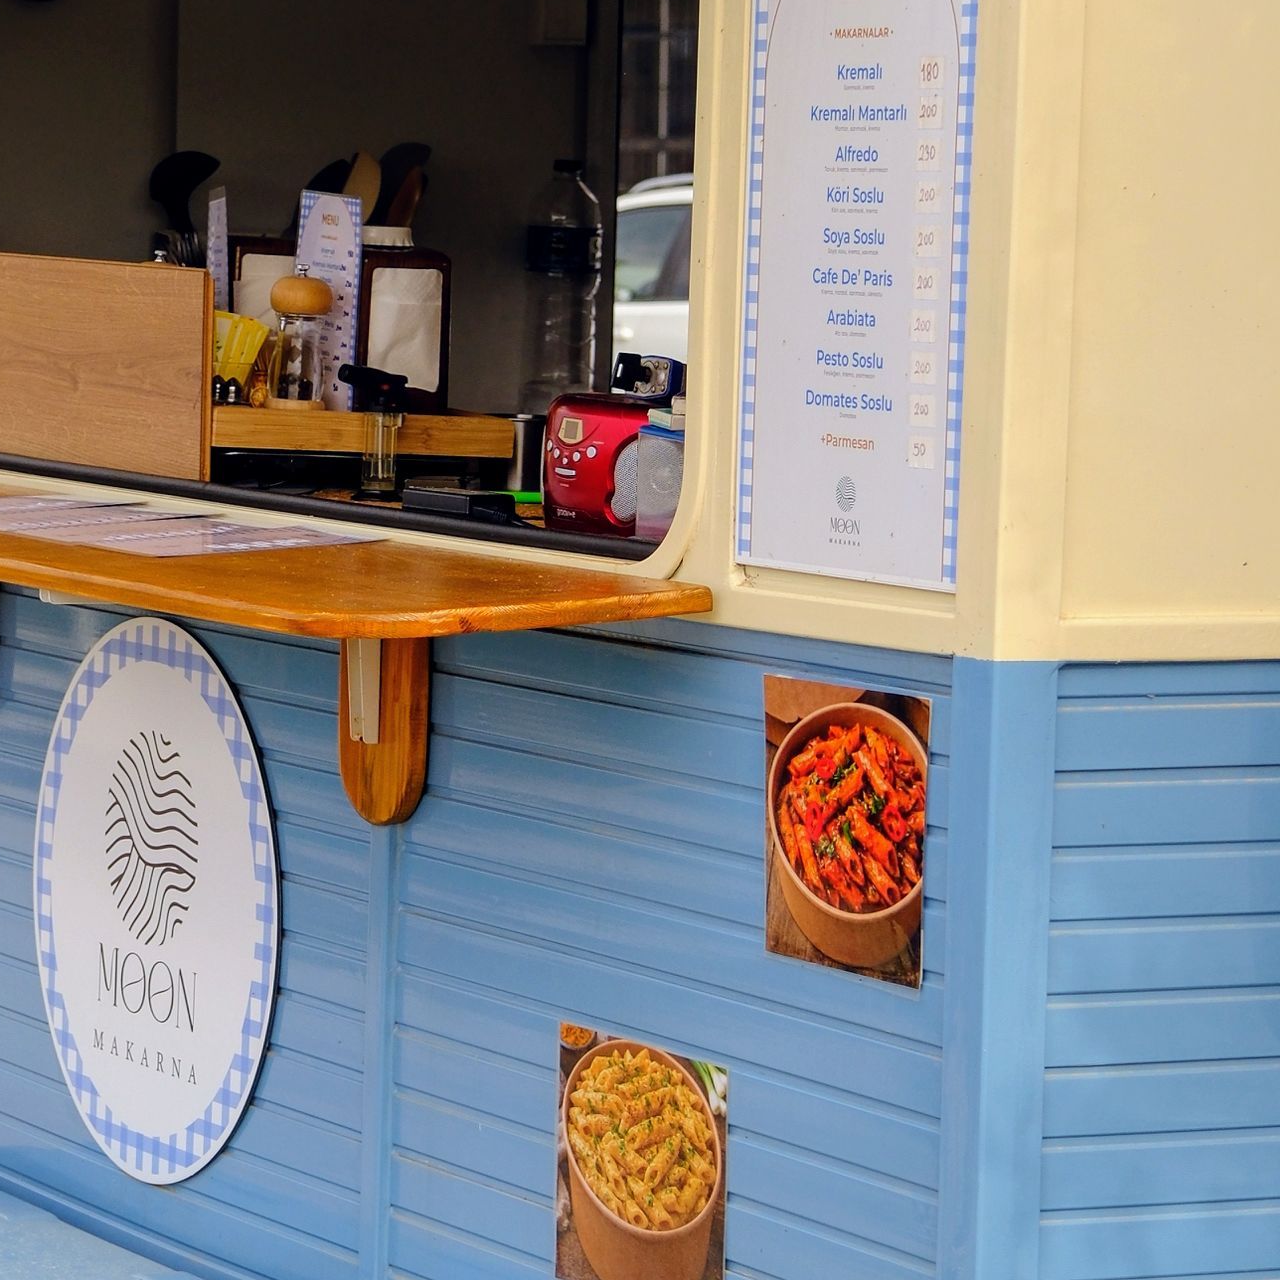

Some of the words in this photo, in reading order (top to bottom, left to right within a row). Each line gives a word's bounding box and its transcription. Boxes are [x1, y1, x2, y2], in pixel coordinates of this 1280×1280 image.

[836, 63, 883, 81] Kremalı
[920, 62, 939, 83] 180
[810, 104, 856, 122] Kremalı
[858, 105, 907, 121] Mantarlı
[919, 104, 937, 119] 200
[835, 145, 879, 163] Alfredo
[918, 144, 936, 161] 230
[826, 186, 850, 204] Köri
[852, 187, 884, 204] Soslu
[823, 228, 850, 246] Soya
[853, 228, 885, 245] Soslu
[917, 232, 934, 247] 200
[812, 268, 838, 285] Cafe
[841, 269, 861, 286] De'
[863, 270, 893, 288] Paris
[916, 276, 933, 290] 200
[826, 310, 876, 328] Arabiata
[913, 319, 931, 333] 200
[816, 350, 849, 368] Pesto
[851, 352, 884, 370] Soslu
[914, 362, 931, 374] 200
[805, 390, 858, 409] Domates
[860, 394, 893, 412] Soslu
[914, 403, 929, 416] 200
[820, 433, 875, 451] +Parmesan
[912, 443, 926, 457] 50
[830, 517, 860, 535] MOON
[97, 941, 198, 1034] MOON
[92, 1029, 199, 1086] MAKARNA
